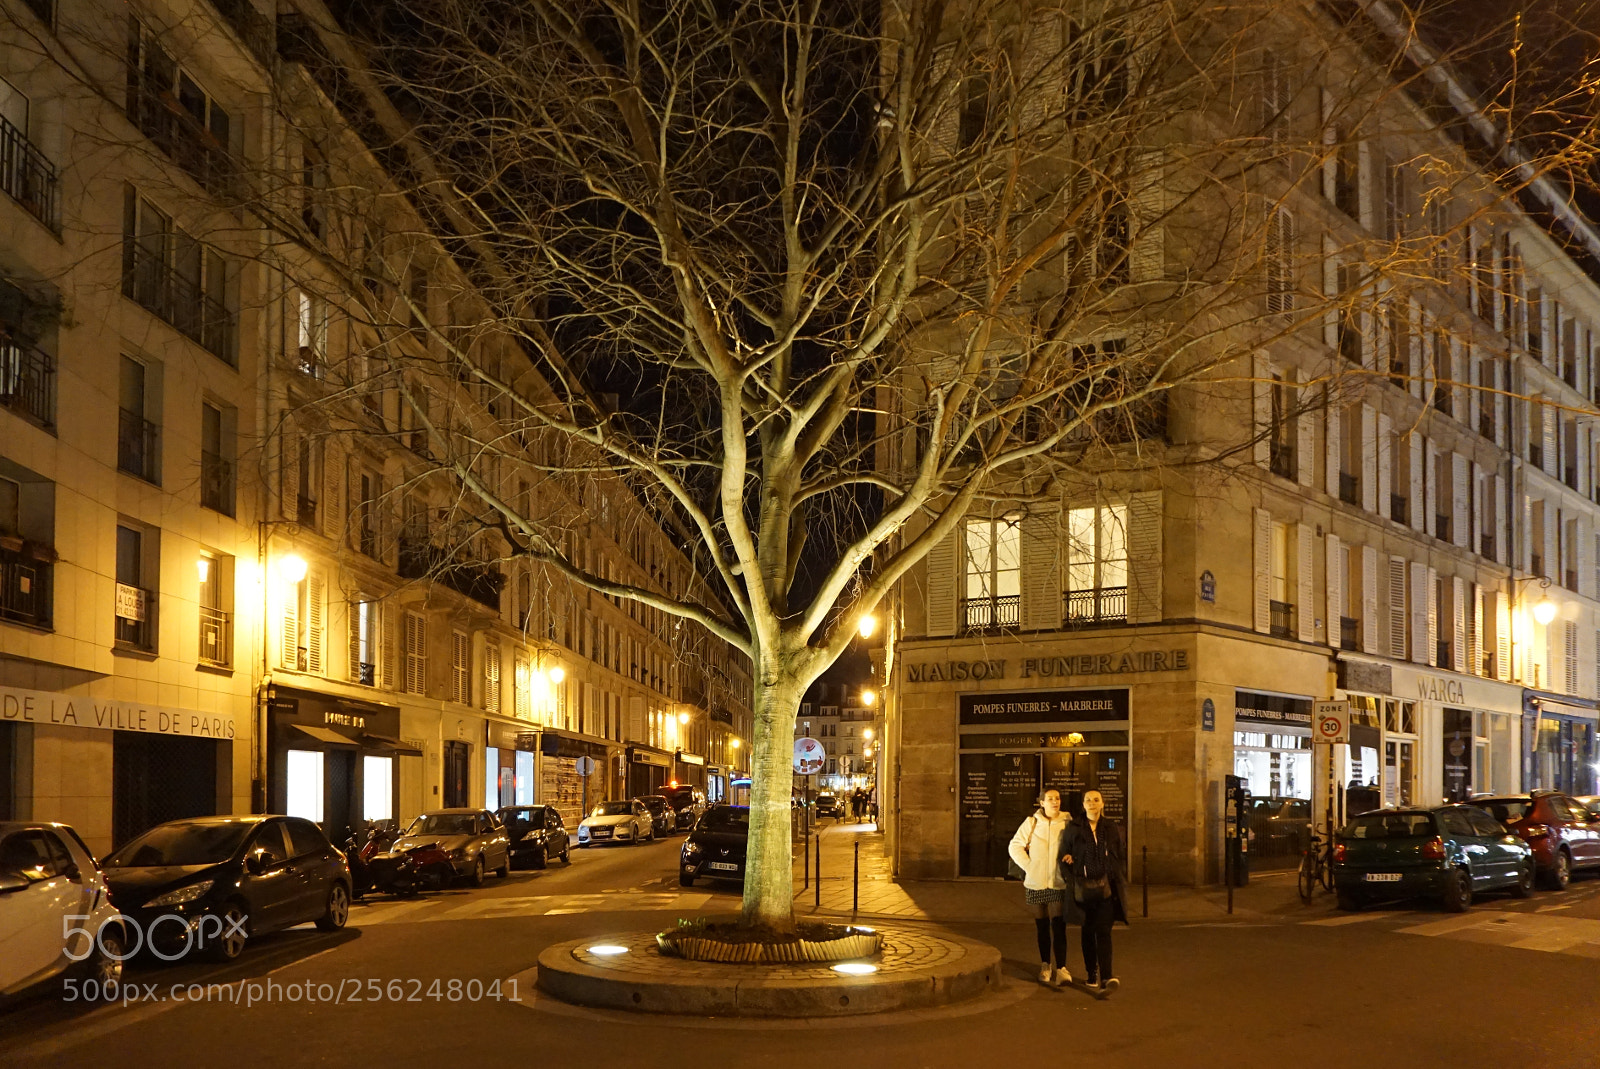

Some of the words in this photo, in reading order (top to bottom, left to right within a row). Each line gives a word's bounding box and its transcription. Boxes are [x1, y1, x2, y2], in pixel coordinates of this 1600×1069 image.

[124, 595, 143, 610] LOUER
[906, 659, 1007, 682] MAISON
[1019, 650, 1189, 679] FUNERAIRE
[1416, 675, 1465, 704] WARGA
[972, 704, 1005, 714] POMPES
[1006, 701, 1050, 713] FUNEBRES
[1059, 700, 1113, 711] MARBRERIE
[1235, 707, 1256, 718] POMPES
[1256, 709, 1281, 720] FUNEBRES
[1320, 705, 1343, 713] ZONE
[3, 694, 35, 720] DE
[51, 699, 77, 724] LA
[94, 704, 147, 731] VILLE
[158, 712, 181, 734] DE
[190, 715, 235, 739] PARIS
[1324, 722, 1338, 732] 30
[999, 736, 1033, 745] ROGER
